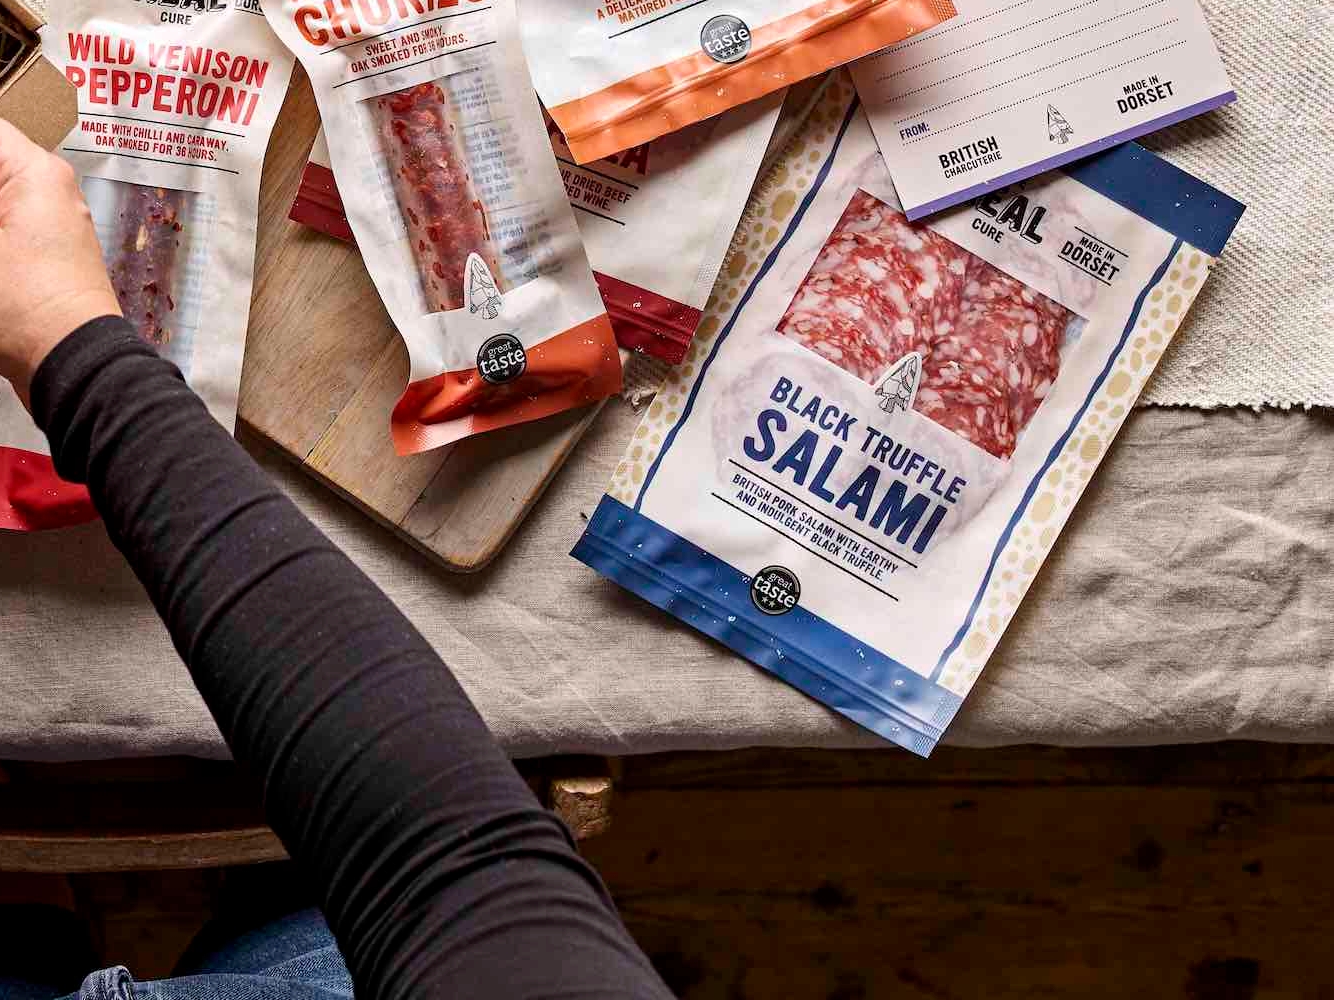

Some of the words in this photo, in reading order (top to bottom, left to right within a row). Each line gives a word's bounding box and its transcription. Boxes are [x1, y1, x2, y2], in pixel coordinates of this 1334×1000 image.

[160, 11, 193, 25] CURE
[68, 33, 136, 65] WILD
[149, 43, 270, 89] VENISON
[66, 66, 261, 126] PEPPERONI
[1116, 80, 1174, 114] DORSET
[1122, 79, 1148, 95] MADE
[1148, 74, 1159, 86] IN
[899, 121, 930, 141] FROM:
[938, 135, 999, 169] BRITISH
[944, 150, 1003, 179] CHARCUTERIE
[572, 173, 603, 195] DRIED
[604, 187, 633, 204] BEEF
[583, 191, 611, 212] WINE.
[971, 217, 1005, 244] CURE
[1060, 240, 1120, 281] DORSET
[1078, 236, 1105, 256] MADE
[1103, 250, 1116, 262] IN
[478, 347, 528, 375] taste
[486, 340, 514, 357] great
[769, 375, 859, 443] BLACK
[860, 425, 967, 504] TRUFFLE
[743, 408, 948, 555] SALAMI
[732, 473, 773, 502] BRITISH
[771, 495, 799, 517] PORK
[798, 511, 836, 540] SALAMI
[835, 532, 861, 553] WITH
[859, 546, 899, 574] EARTHY
[735, 490, 758, 507] AND
[757, 501, 812, 537] INDULGENT
[809, 532, 842, 557] BLACK
[842, 550, 884, 582] TRUFFLE.
[751, 574, 799, 610] taste
[766, 570, 795, 593] great
